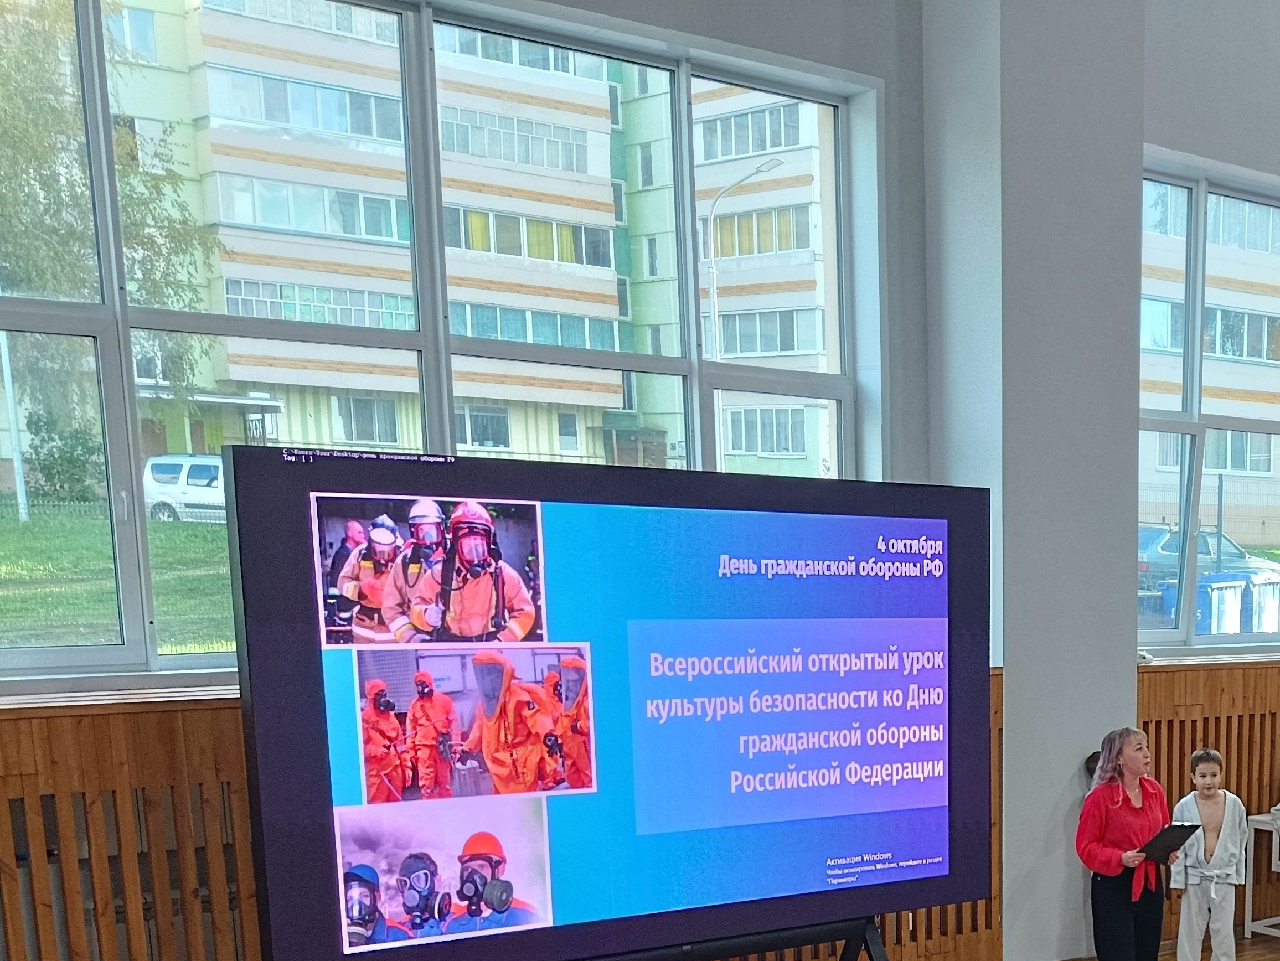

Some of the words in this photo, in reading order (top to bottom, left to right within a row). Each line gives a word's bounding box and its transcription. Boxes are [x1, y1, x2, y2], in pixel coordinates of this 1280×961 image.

[877, 535, 886, 553] 4
[888, 536, 943, 558] октября
[718, 555, 758, 578] День
[760, 556, 856, 579] гражданской
[859, 557, 921, 581] обороны
[923, 559, 944, 578] РФ
[650, 648, 803, 681] Всероссийский
[808, 645, 899, 677] открытый
[902, 650, 944, 675] урок
[646, 695, 744, 724] культуры
[749, 689, 878, 713] безопасности
[882, 689, 903, 707] ко
[907, 684, 944, 710] Дню
[739, 722, 861, 759] гражданской
[866, 721, 944, 749] обороны
[730, 761, 841, 793] Российской
[845, 759, 944, 786] Федерации
[863, 852, 893, 862] Windows
